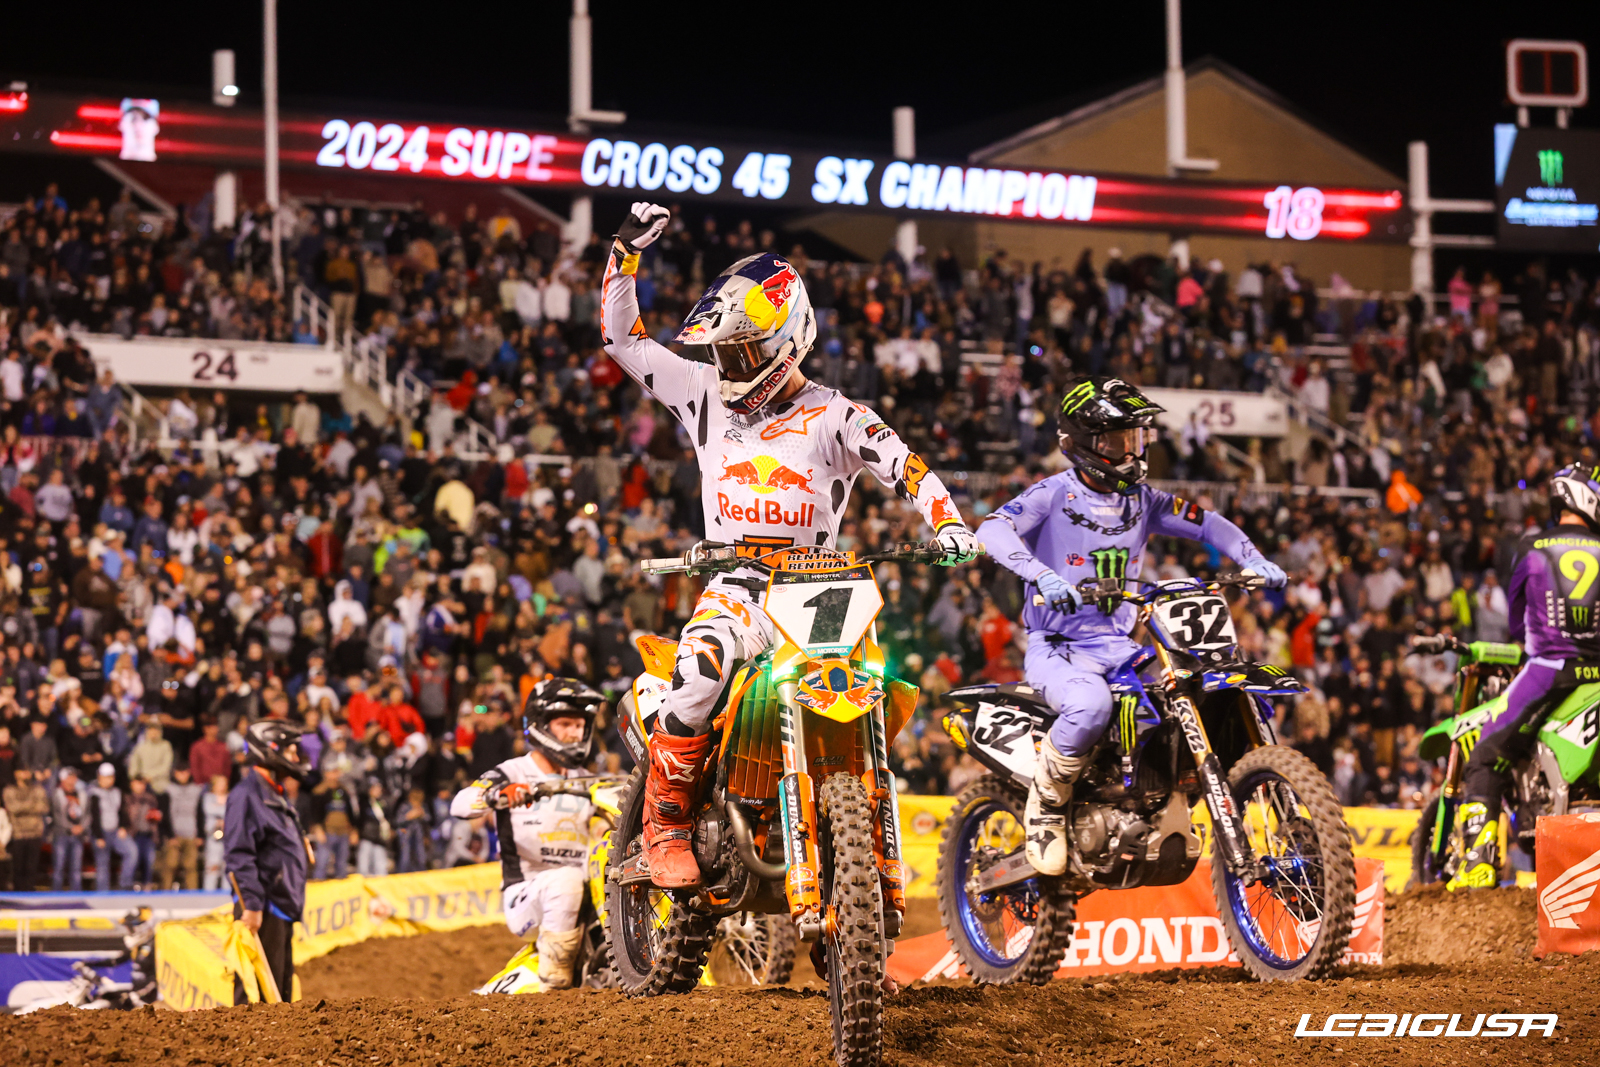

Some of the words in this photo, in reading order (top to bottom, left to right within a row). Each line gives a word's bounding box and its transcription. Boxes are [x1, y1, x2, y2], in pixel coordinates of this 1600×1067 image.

[316, 119, 429, 173] 2024
[581, 138, 725, 195] CROSS
[732, 152, 792, 200] 45
[811, 156, 874, 206] SX
[879, 161, 1099, 221] CHAMPION
[1263, 185, 1325, 240] 18
[192, 351, 238, 381] 24
[743, 380, 774, 410] Red
[768, 355, 796, 385] Bull
[1200, 401, 1235, 427] 25
[717, 491, 760, 524] Red
[764, 497, 815, 528] Bull
[787, 552, 850, 561] RENTHAL
[1559, 550, 1600, 600] 9
[803, 587, 854, 644] 1
[1169, 599, 1233, 647] 32
[1574, 666, 1600, 680] FOX
[974, 711, 1032, 756] 32
[1174, 698, 1208, 754] KYB
[1206, 772, 1237, 838] DUNLOP
[1060, 916, 1240, 968] HOND
